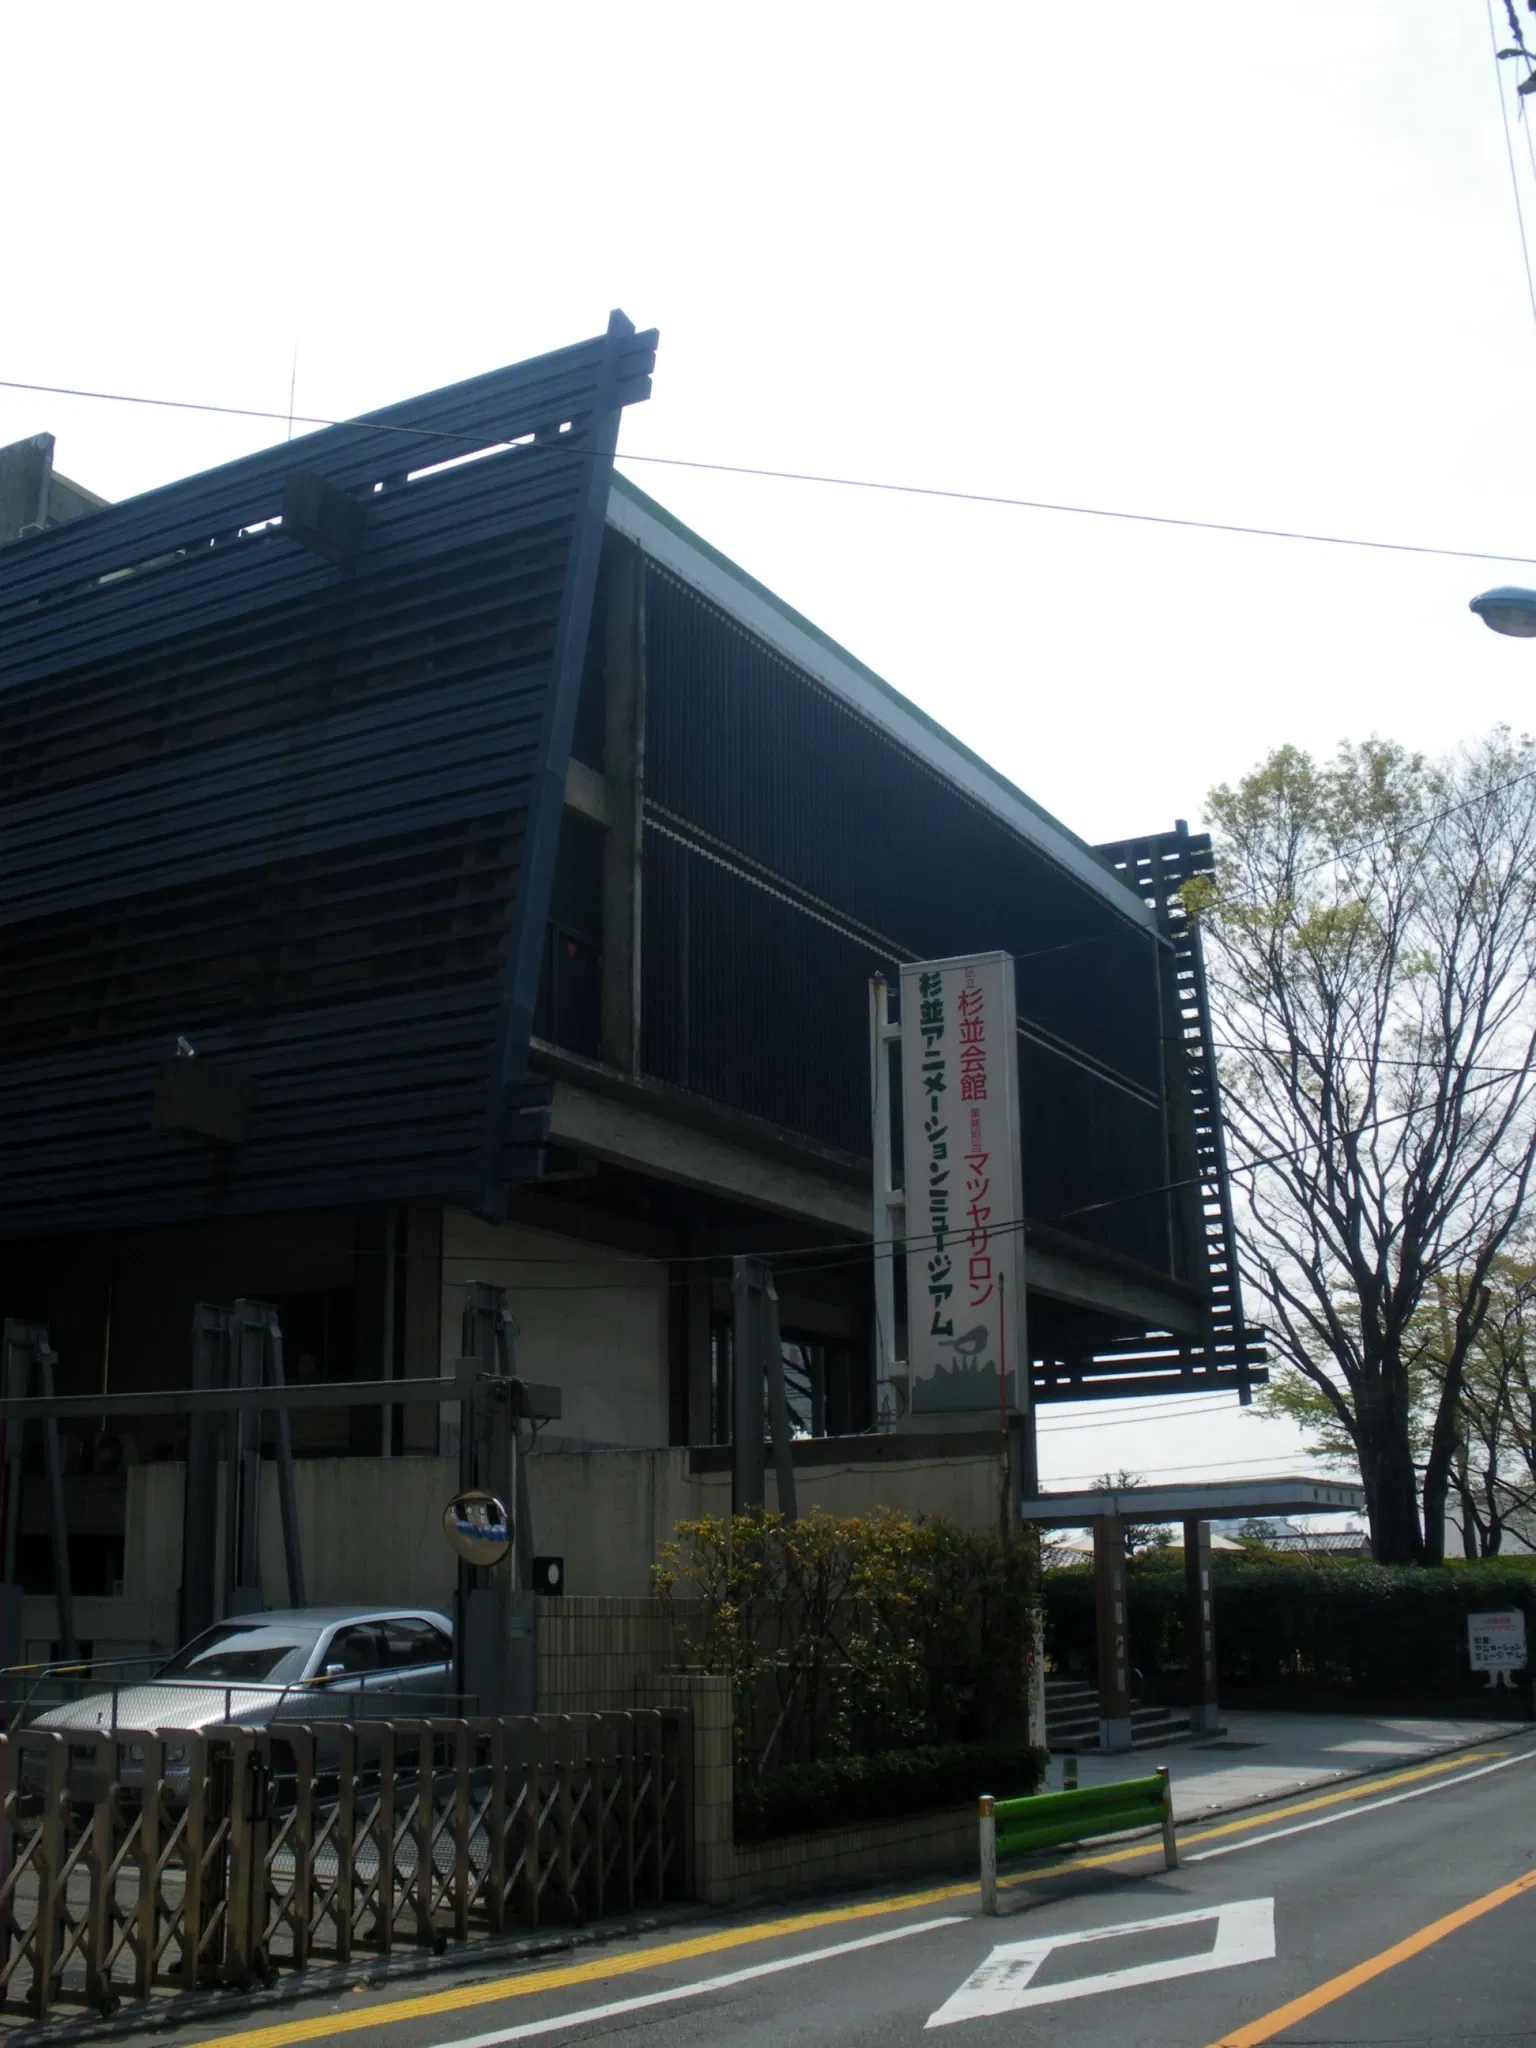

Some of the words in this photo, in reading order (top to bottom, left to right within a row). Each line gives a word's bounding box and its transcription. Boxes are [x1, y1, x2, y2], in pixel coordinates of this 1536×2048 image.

[958, 988, 987, 1101] 杉並会館
[919, 971, 953, 1336] 杉並アニメーションミュージアム
[964, 1153, 993, 1307] マツヤサロン
